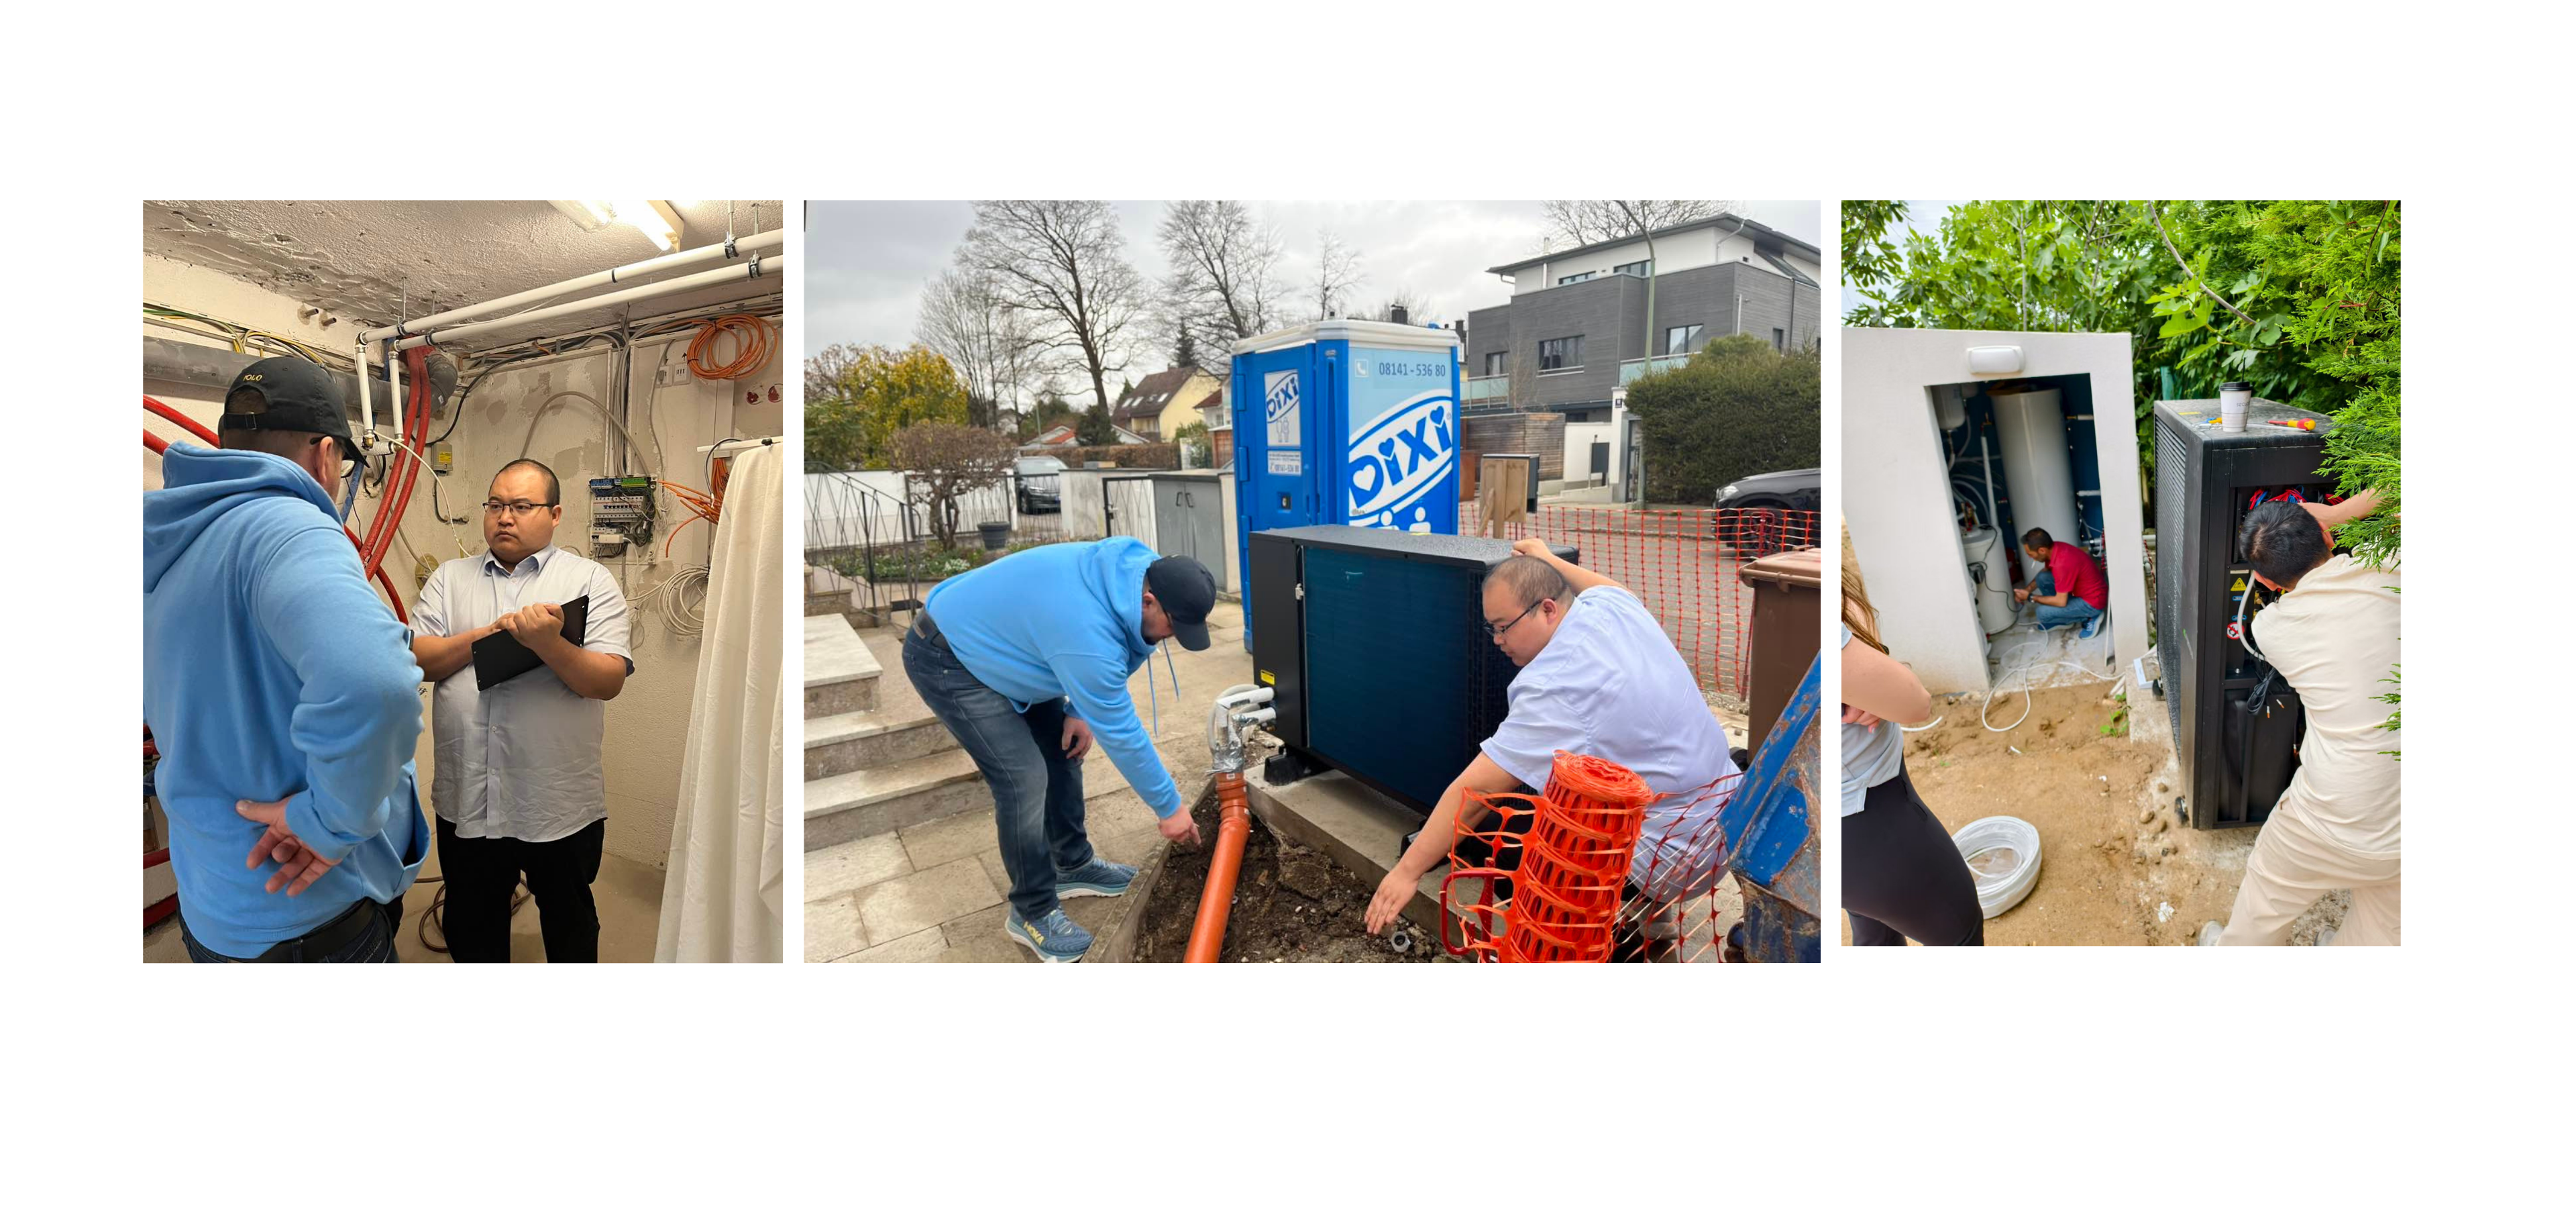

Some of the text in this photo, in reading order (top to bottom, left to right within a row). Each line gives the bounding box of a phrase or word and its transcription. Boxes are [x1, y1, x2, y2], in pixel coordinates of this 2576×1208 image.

[1379, 362, 1408, 376] 08141
[1415, 364, 1433, 376] 536
[1435, 364, 1446, 376] 80
